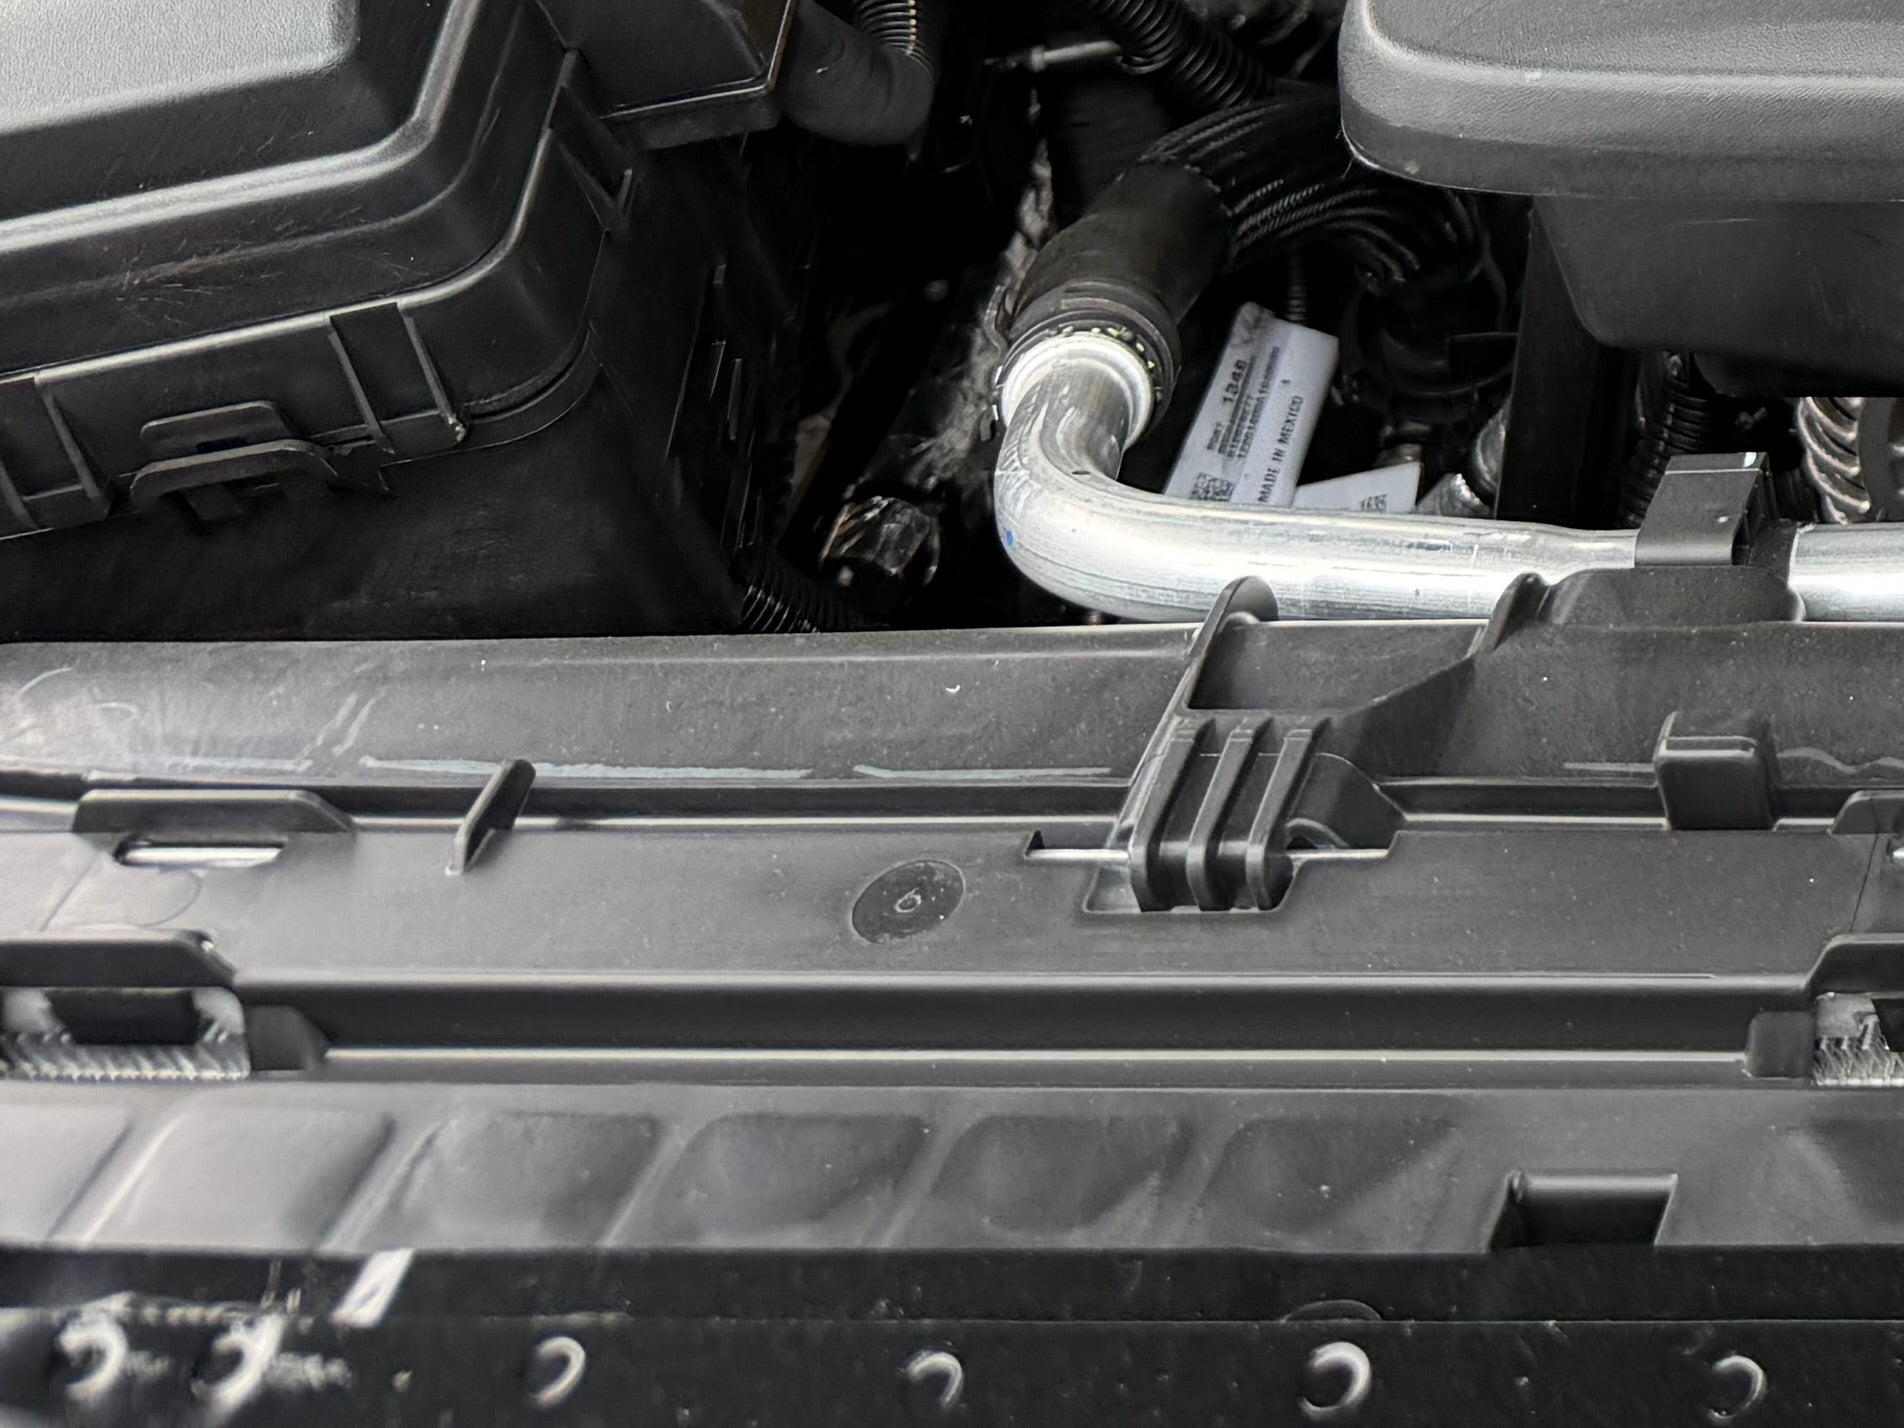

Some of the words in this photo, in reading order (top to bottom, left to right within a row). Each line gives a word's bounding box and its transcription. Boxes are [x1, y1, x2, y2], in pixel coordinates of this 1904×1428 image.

[1277, 394, 1304, 445] MEXICO
[1271, 447, 1287, 463] IN
[1257, 467, 1280, 503] MADE
